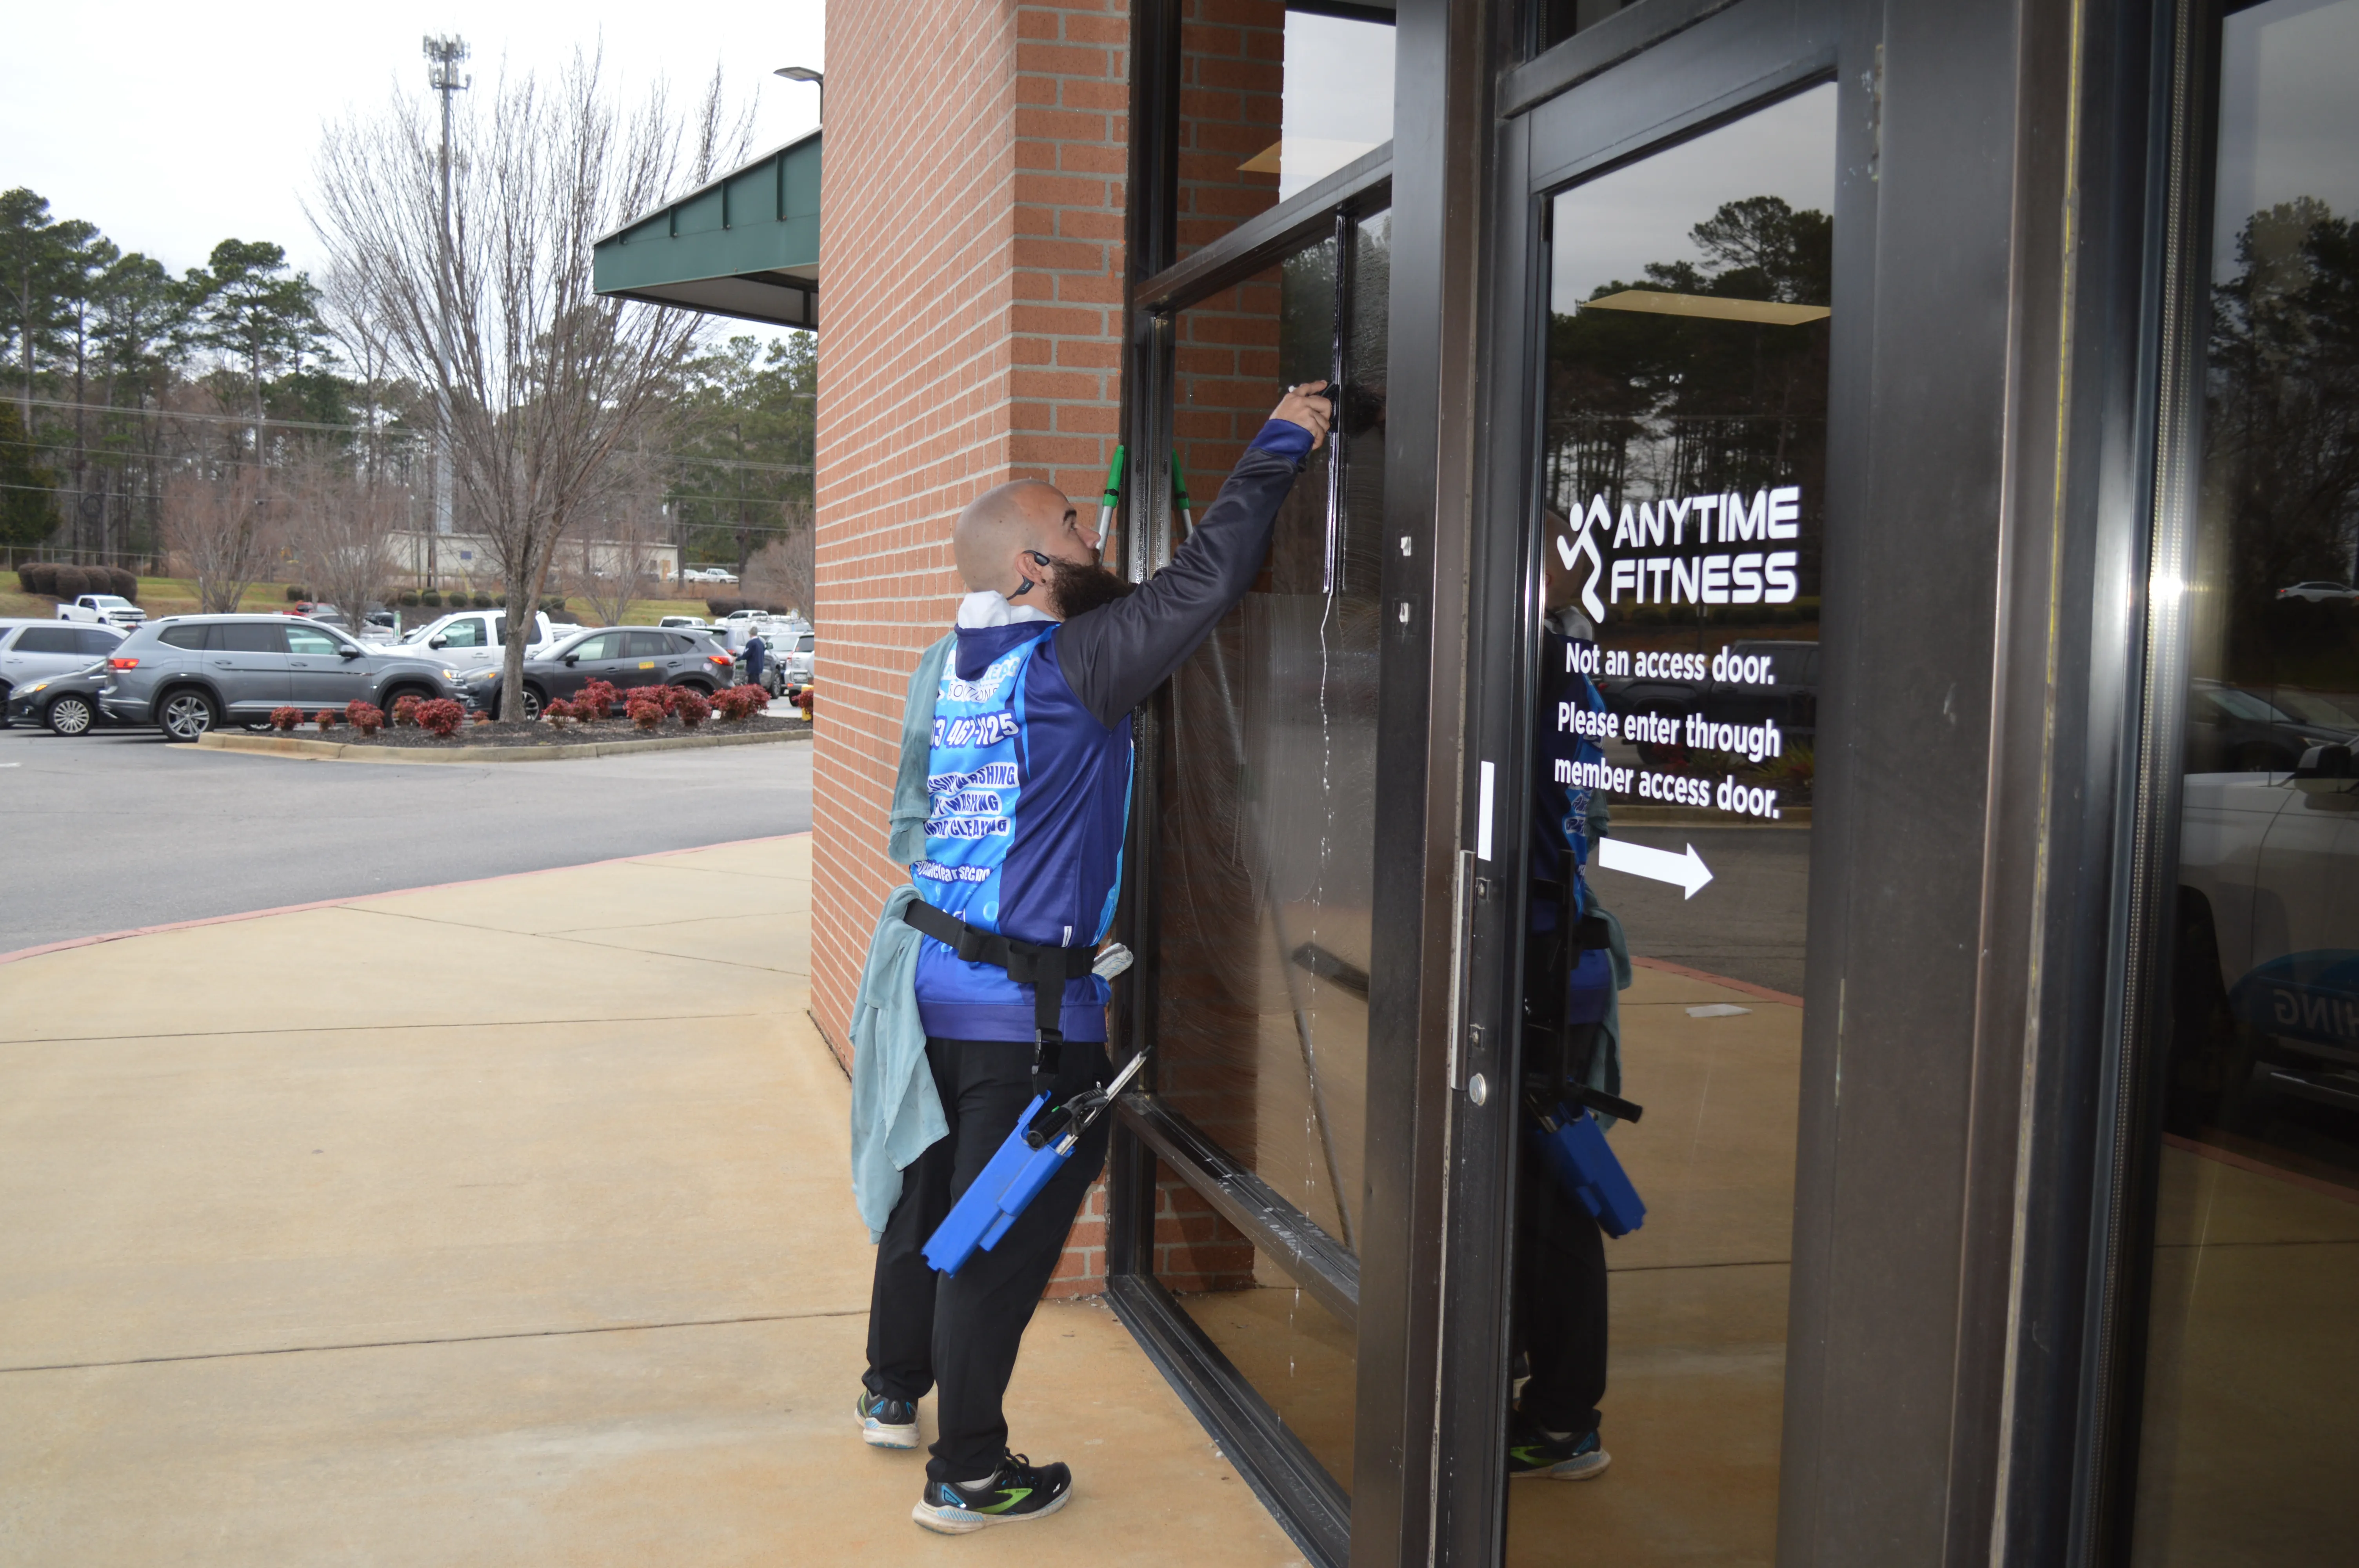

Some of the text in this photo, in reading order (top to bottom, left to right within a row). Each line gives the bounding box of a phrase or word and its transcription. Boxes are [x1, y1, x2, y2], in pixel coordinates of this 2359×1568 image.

[1613, 486, 1799, 548] ANYTIME
[1611, 552, 1797, 604] FITNESS
[1566, 642, 1774, 684] Not an access door.
[947, 713, 1019, 745] 467-1125
[1558, 701, 1780, 762] Please enter through
[1554, 757, 1779, 819] member access door.
